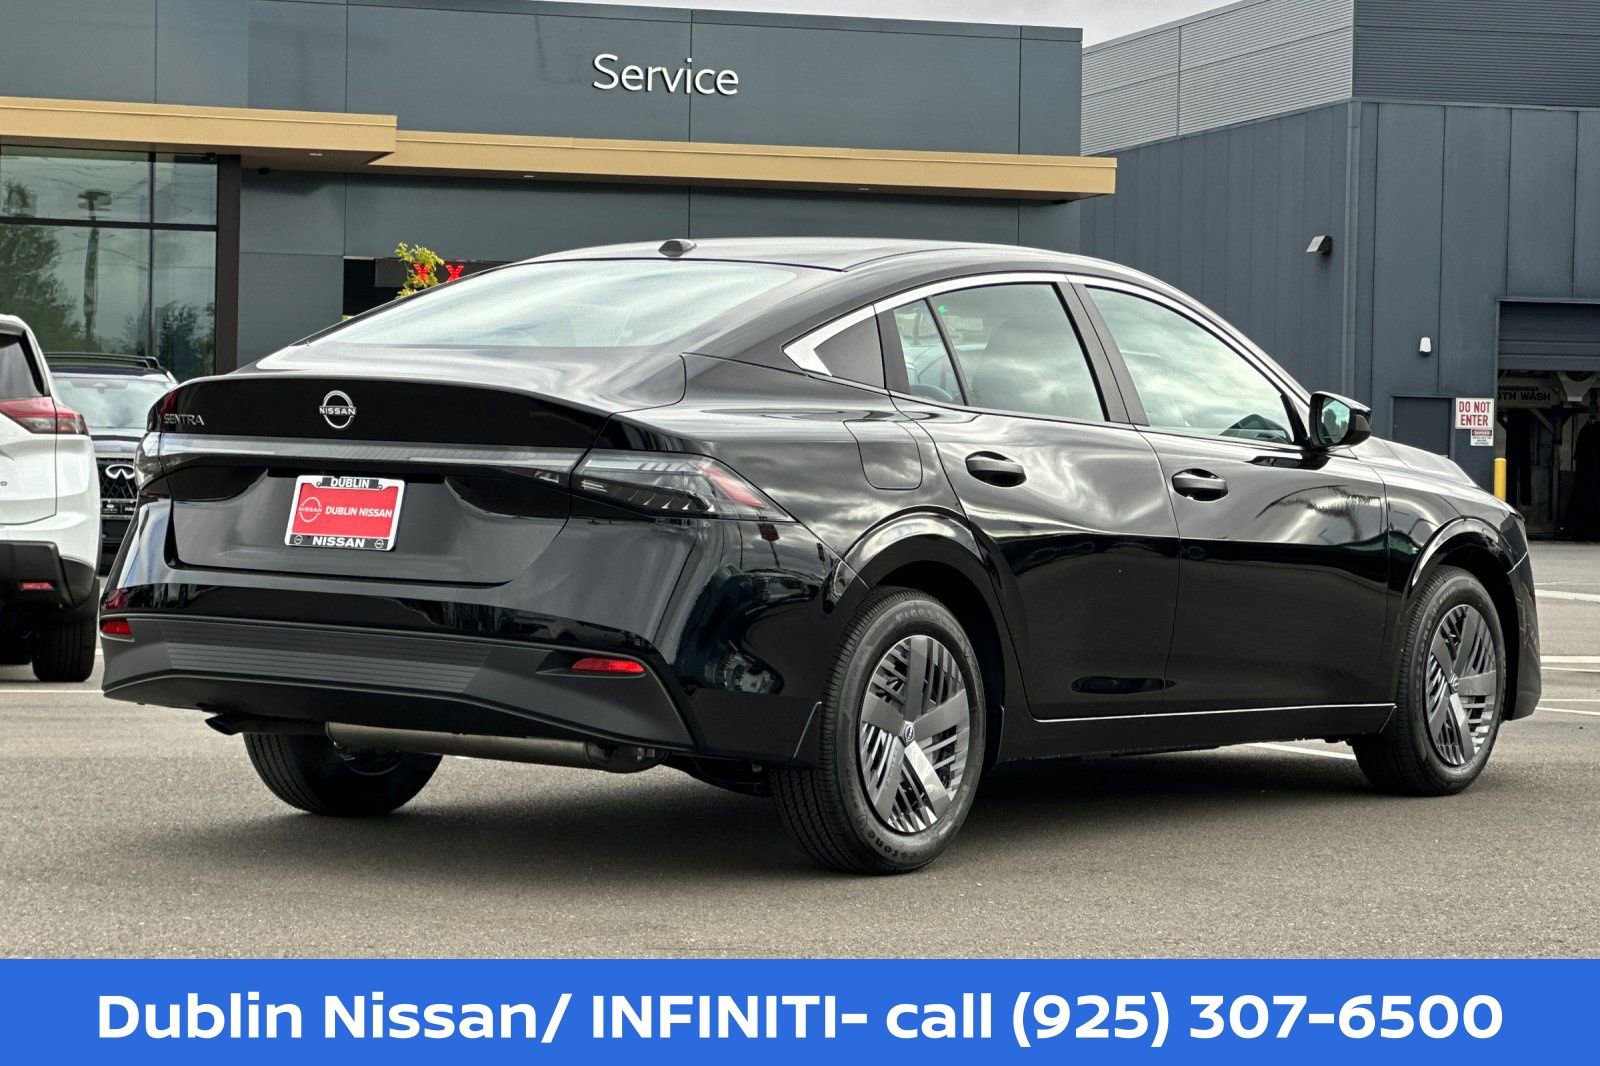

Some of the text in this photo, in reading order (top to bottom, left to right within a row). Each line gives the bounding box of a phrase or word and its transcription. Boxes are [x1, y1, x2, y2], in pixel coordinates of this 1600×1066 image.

[593, 53, 739, 95] Service
[1520, 392, 1551, 400] WASH
[319, 406, 356, 416] NISSAN
[1458, 401, 1491, 413] DO NOT
[163, 413, 205, 426] SENTRA
[1460, 414, 1489, 426] ENTER
[330, 478, 370, 488] DUBLIN
[325, 505, 392, 518] DUBLIN NISSAN
[312, 536, 366, 548] NISSAN
